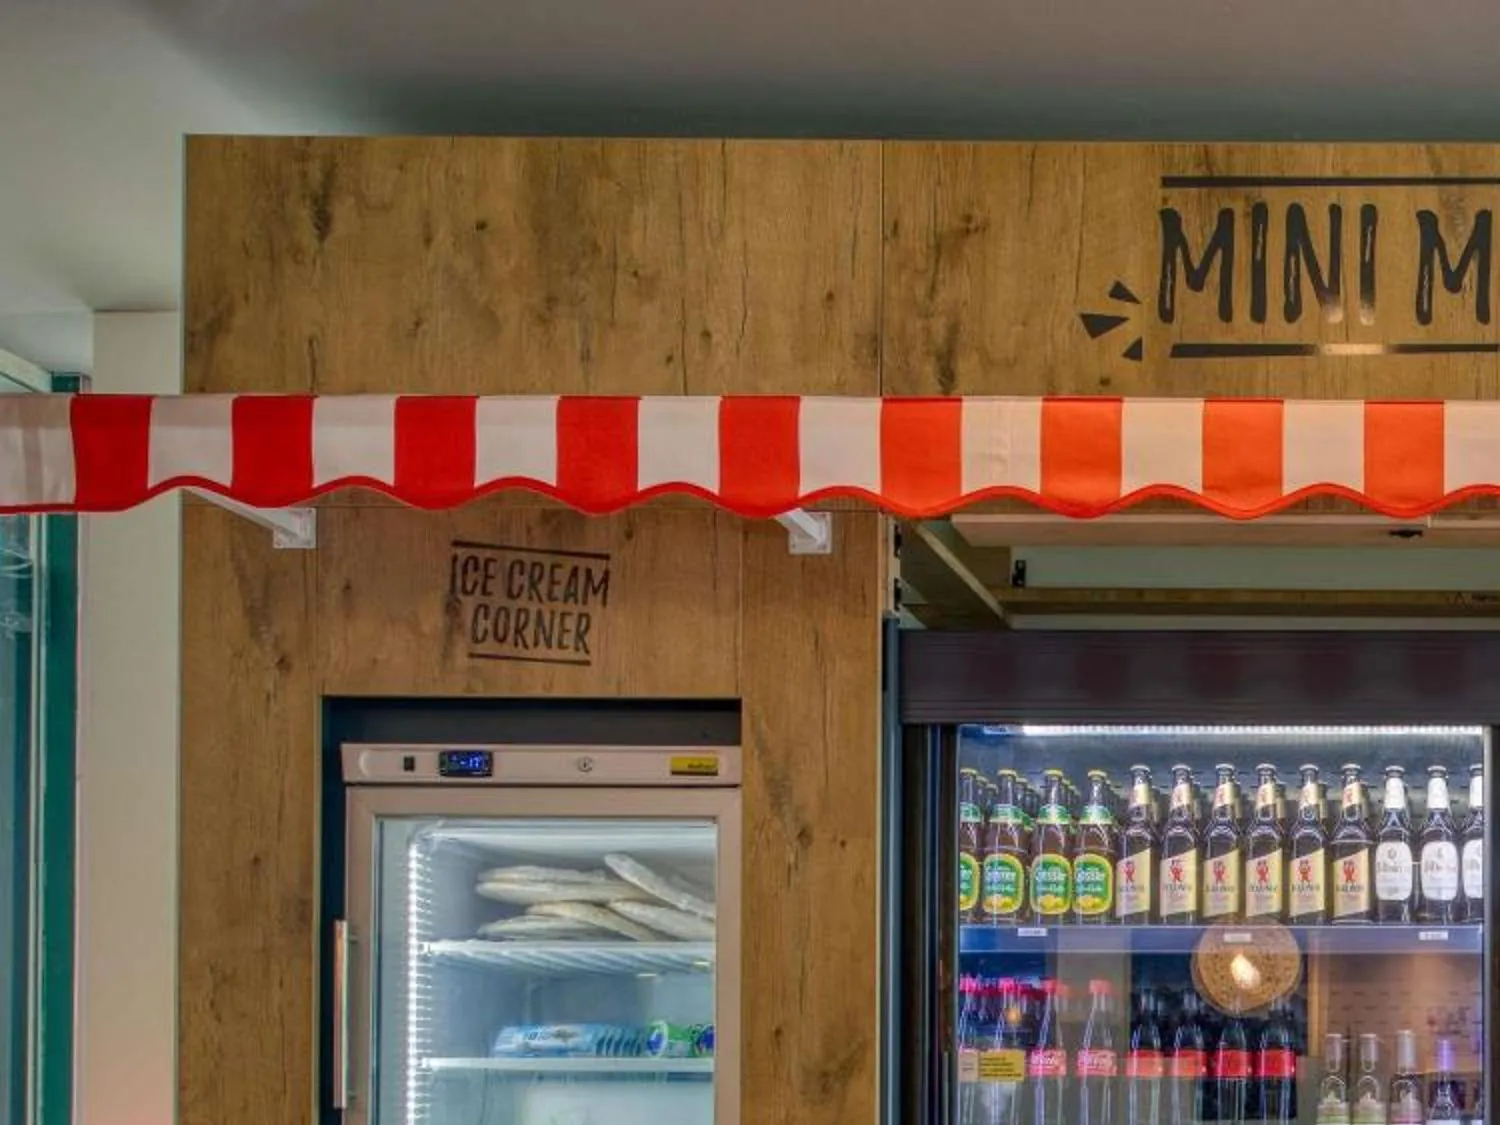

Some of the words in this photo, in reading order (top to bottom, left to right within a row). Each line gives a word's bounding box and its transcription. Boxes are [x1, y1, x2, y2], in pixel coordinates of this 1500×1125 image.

[1158, 202, 1378, 325] MINI
[450, 554, 498, 597] ICE
[507, 559, 610, 608] CREAM
[471, 603, 591, 654] CORNER
